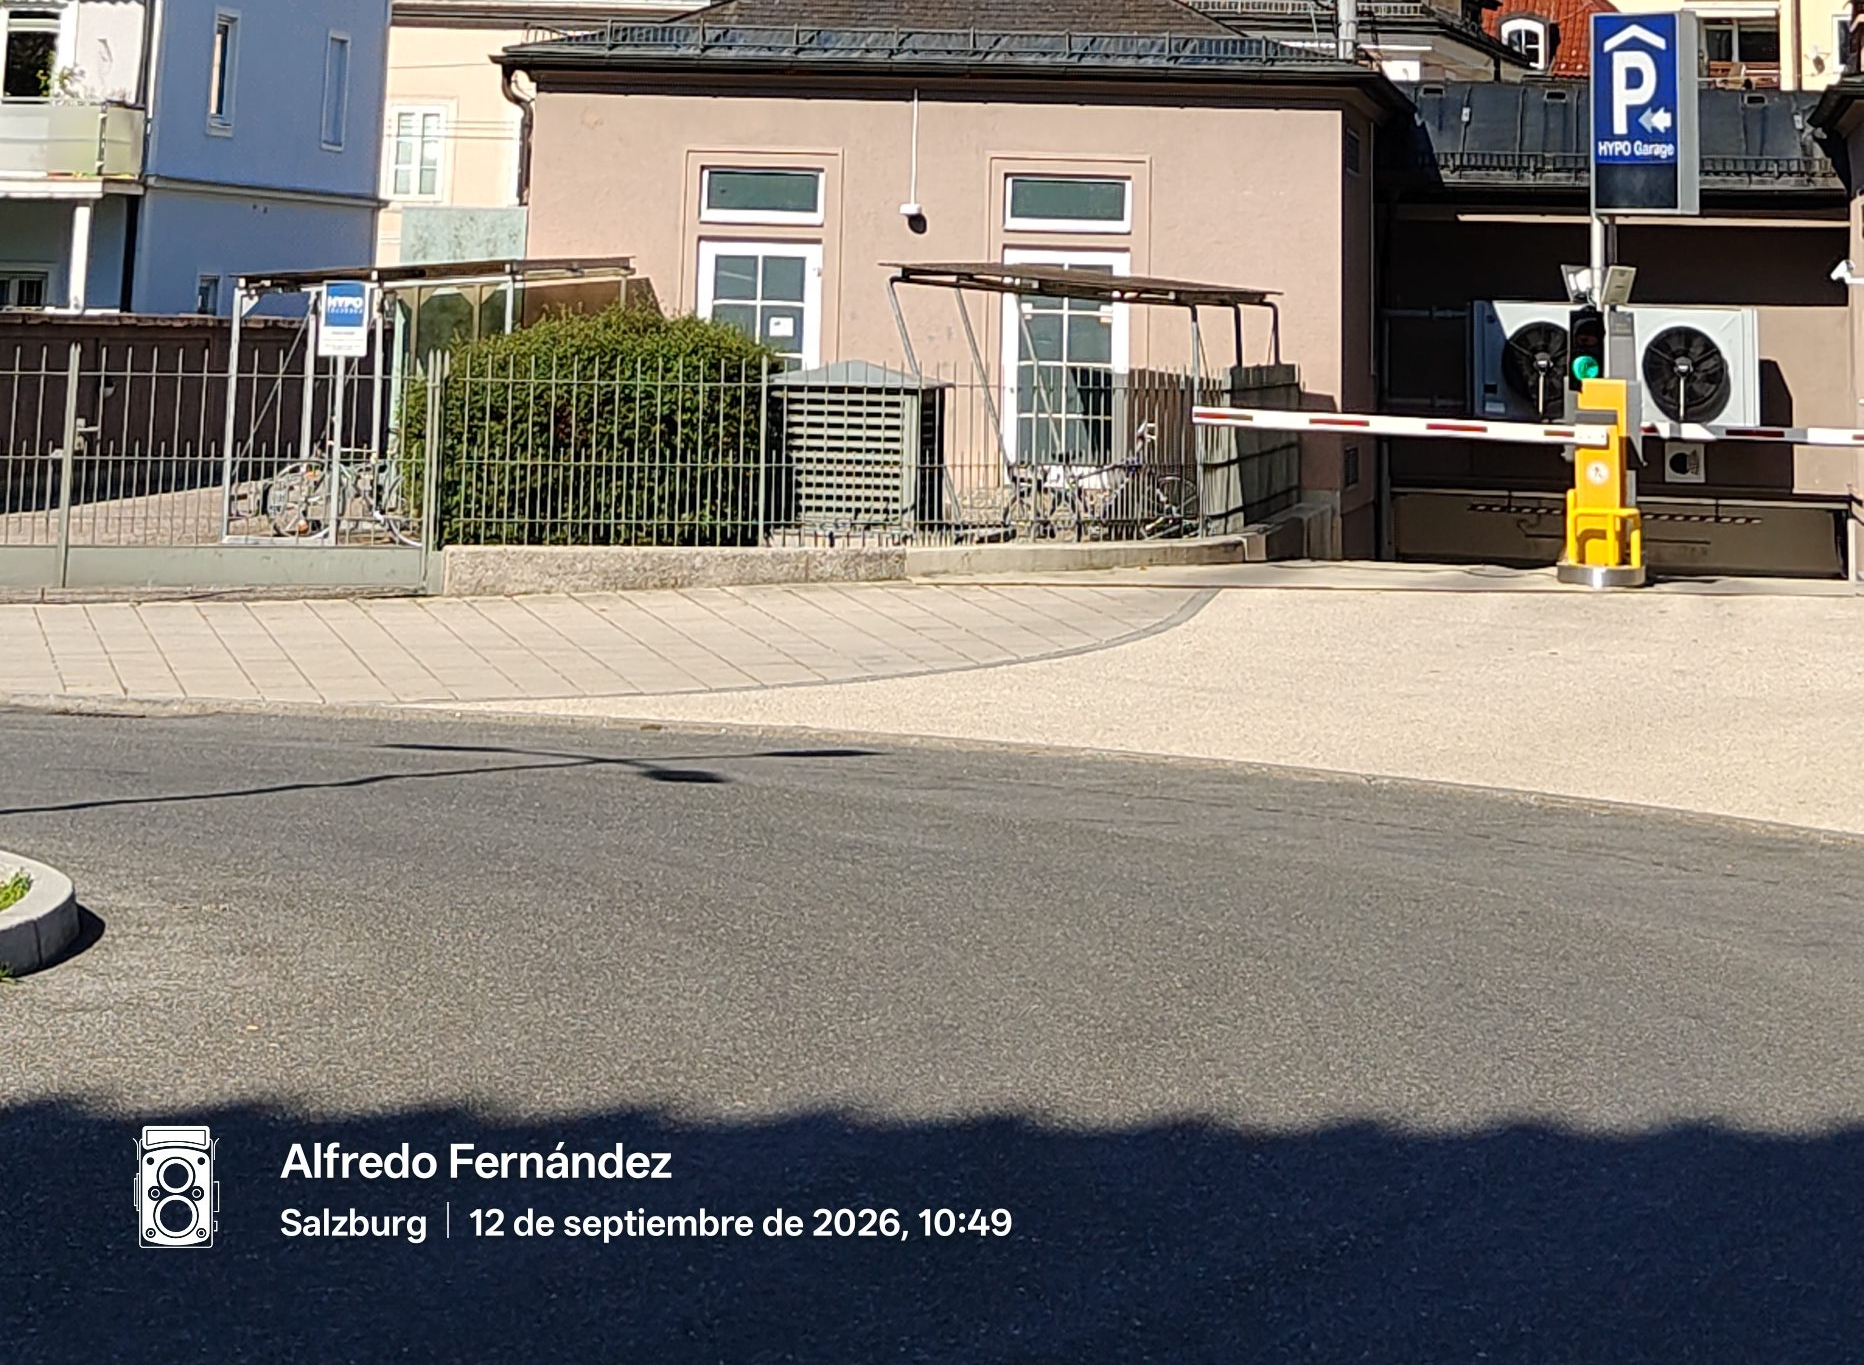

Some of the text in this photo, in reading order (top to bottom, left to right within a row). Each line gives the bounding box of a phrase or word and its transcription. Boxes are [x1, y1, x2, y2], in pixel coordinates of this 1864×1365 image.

[1612, 51, 1657, 134] P
[1598, 140, 1675, 159] HYPO Garage
